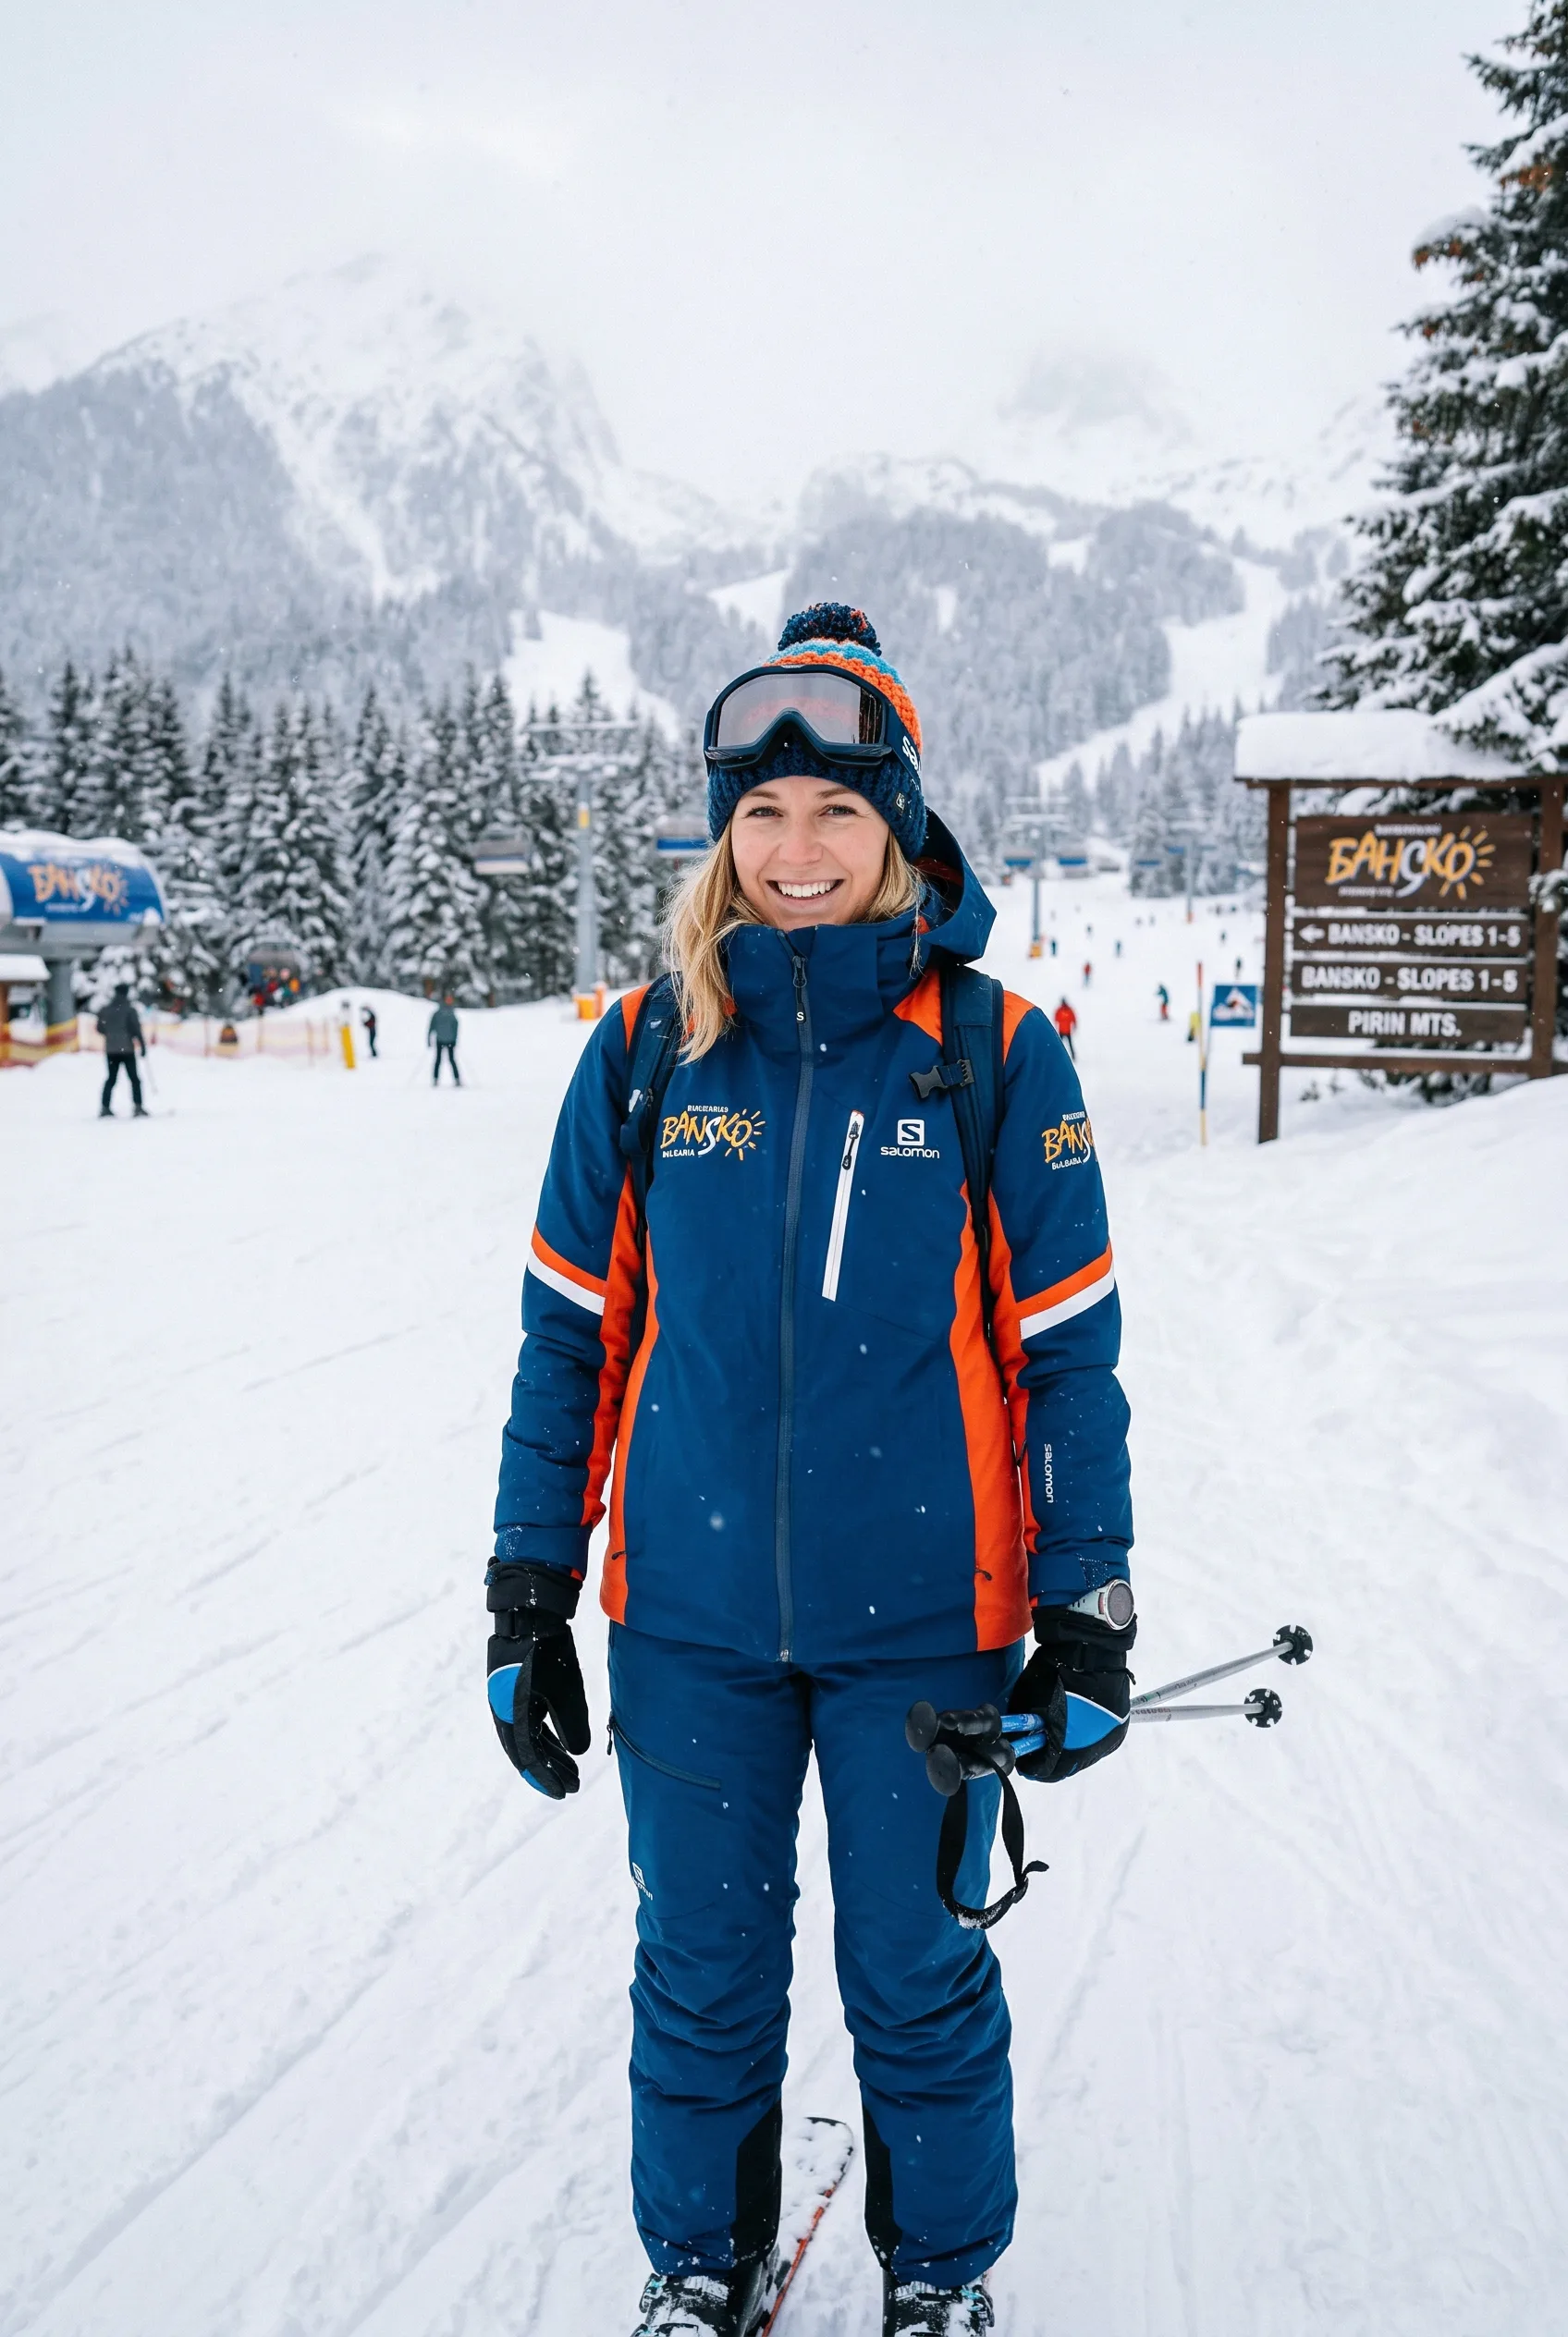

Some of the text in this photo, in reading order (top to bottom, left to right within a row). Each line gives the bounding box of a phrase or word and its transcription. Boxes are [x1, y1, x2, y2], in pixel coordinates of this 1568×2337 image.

[1325, 831, 1476, 898] БАНСКО
[1328, 924, 1400, 946] BANSKO
[1414, 924, 1484, 947] SLOPES
[1301, 966, 1381, 990] BANSKO
[1397, 968, 1475, 992] SLOPES
[1348, 1010, 1462, 1037] PIRIN MTS.
[660, 1110, 753, 1156] BANSKO
